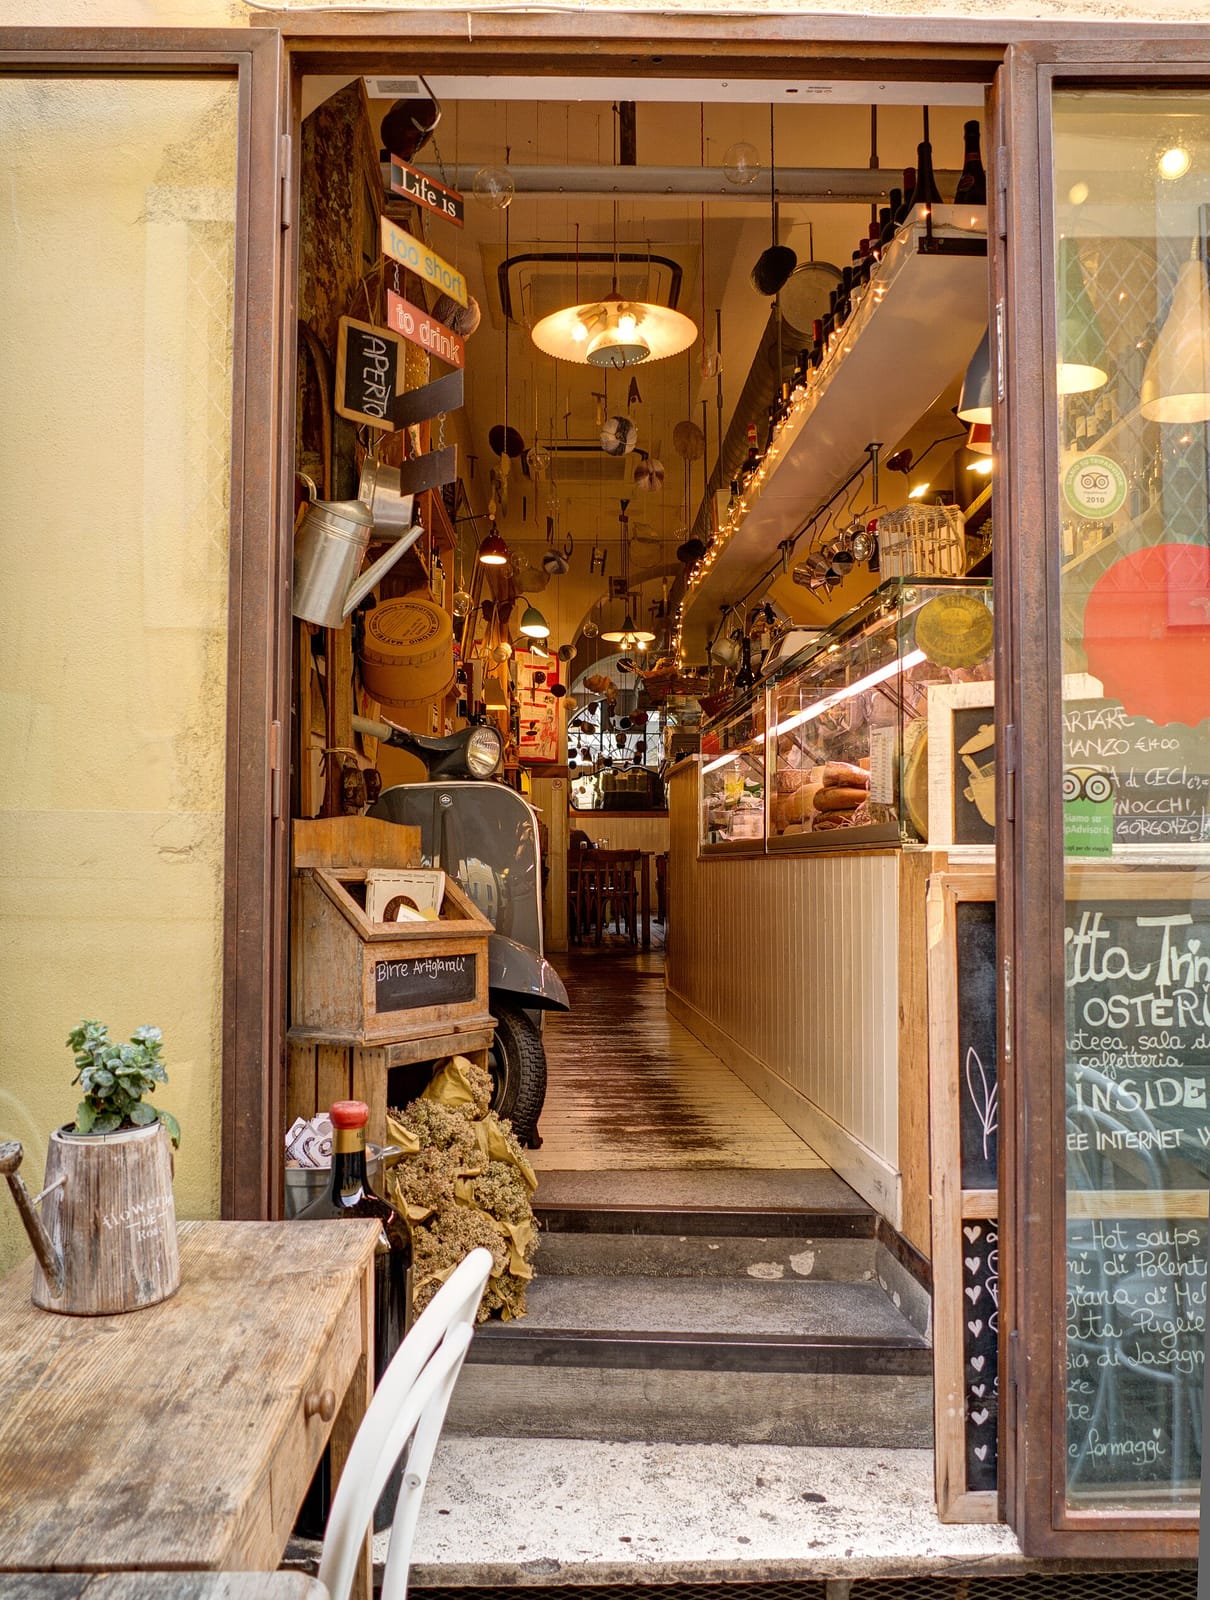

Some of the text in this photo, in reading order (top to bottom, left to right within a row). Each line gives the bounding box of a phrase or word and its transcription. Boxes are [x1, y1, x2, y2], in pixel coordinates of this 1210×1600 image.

[401, 166, 456, 217] Life is
[390, 229, 463, 298] too short
[396, 304, 460, 364] to drink
[361, 334, 392, 418] APERTO
[1086, 496, 1105, 504] 2010
[1144, 764, 1187, 786] CECI
[376, 960, 409, 982] Birre
[1139, 1030, 1186, 1050] sala
[1191, 1032, 1210, 1050] d
[1079, 1052, 1184, 1080] caffetteria
[1096, 1128, 1185, 1151] INTERNET
[1091, 1220, 1200, 1261] Hot soups
[1103, 1252, 1129, 1276] di
[1135, 1250, 1208, 1278] Polent
[1144, 1285, 1168, 1306] di
[1097, 1346, 1122, 1367] di
[1086, 1427, 1166, 1469] formaggi
